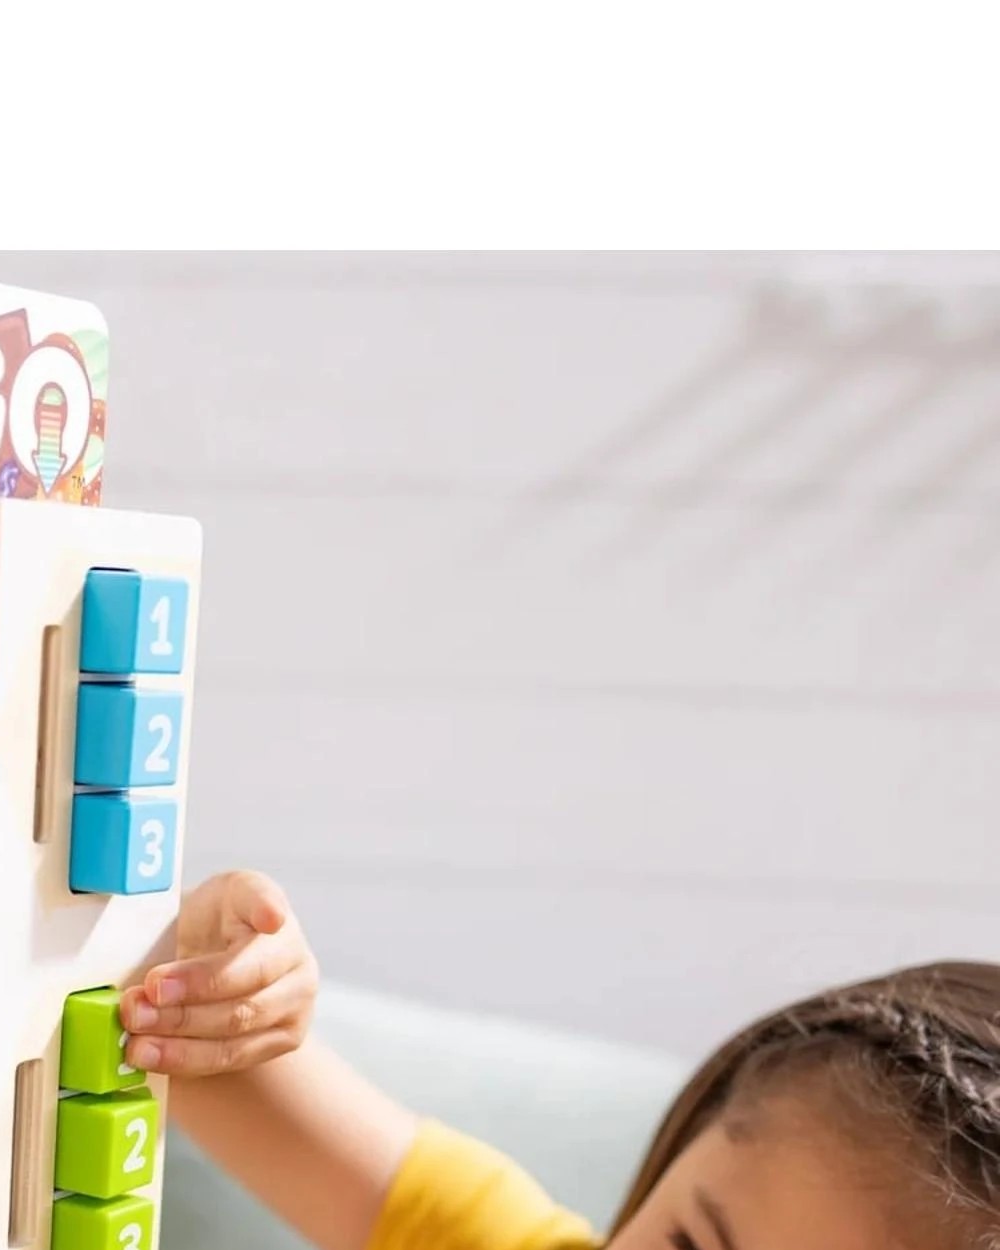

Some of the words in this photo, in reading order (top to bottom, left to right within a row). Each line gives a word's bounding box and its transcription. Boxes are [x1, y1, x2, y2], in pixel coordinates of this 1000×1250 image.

[150, 596, 173, 656] 1
[145, 714, 172, 772] 2
[138, 820, 164, 877] 3
[124, 1117, 147, 1173] 2
